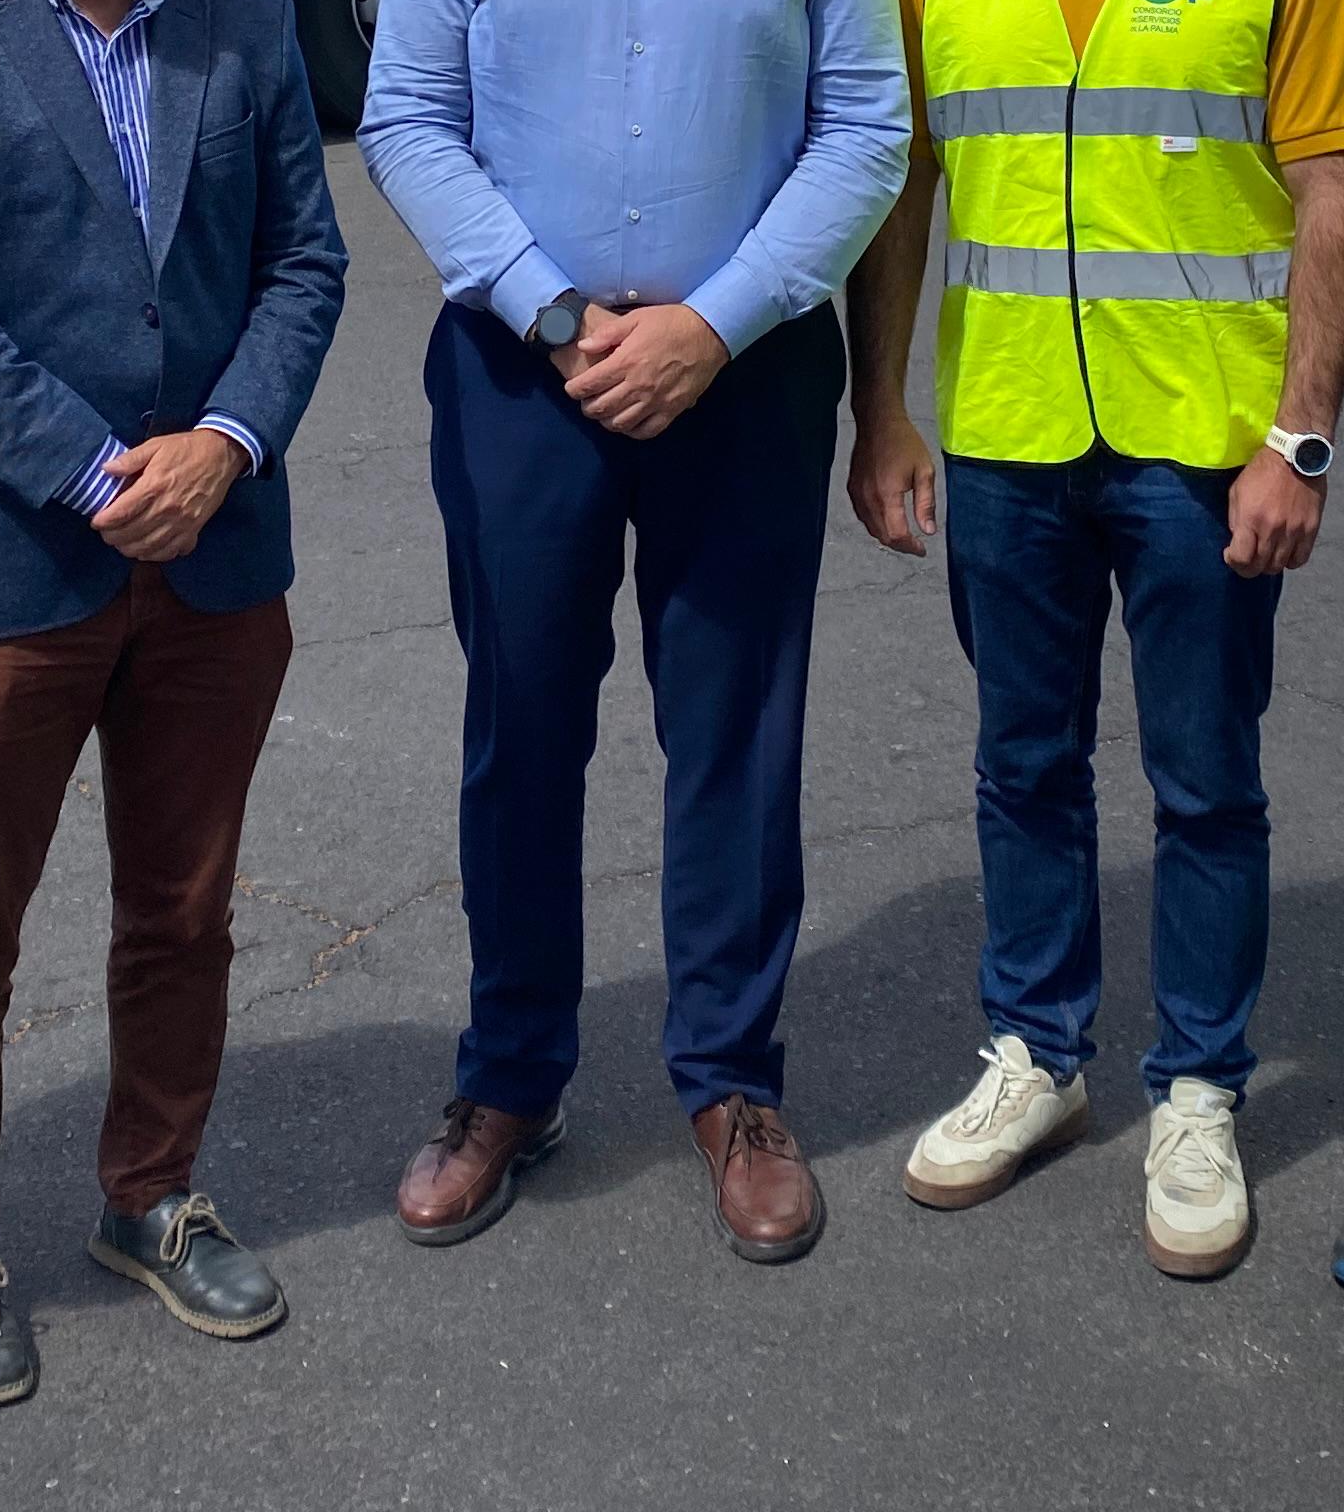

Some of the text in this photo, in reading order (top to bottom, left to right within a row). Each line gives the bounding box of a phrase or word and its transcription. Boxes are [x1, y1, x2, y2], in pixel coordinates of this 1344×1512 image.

[1132, 6, 1182, 16] CONSORCIO
[1137, 15, 1181, 25] SERVICIOS
[1138, 24, 1149, 33] LA
[1150, 24, 1179, 34] PALMA
